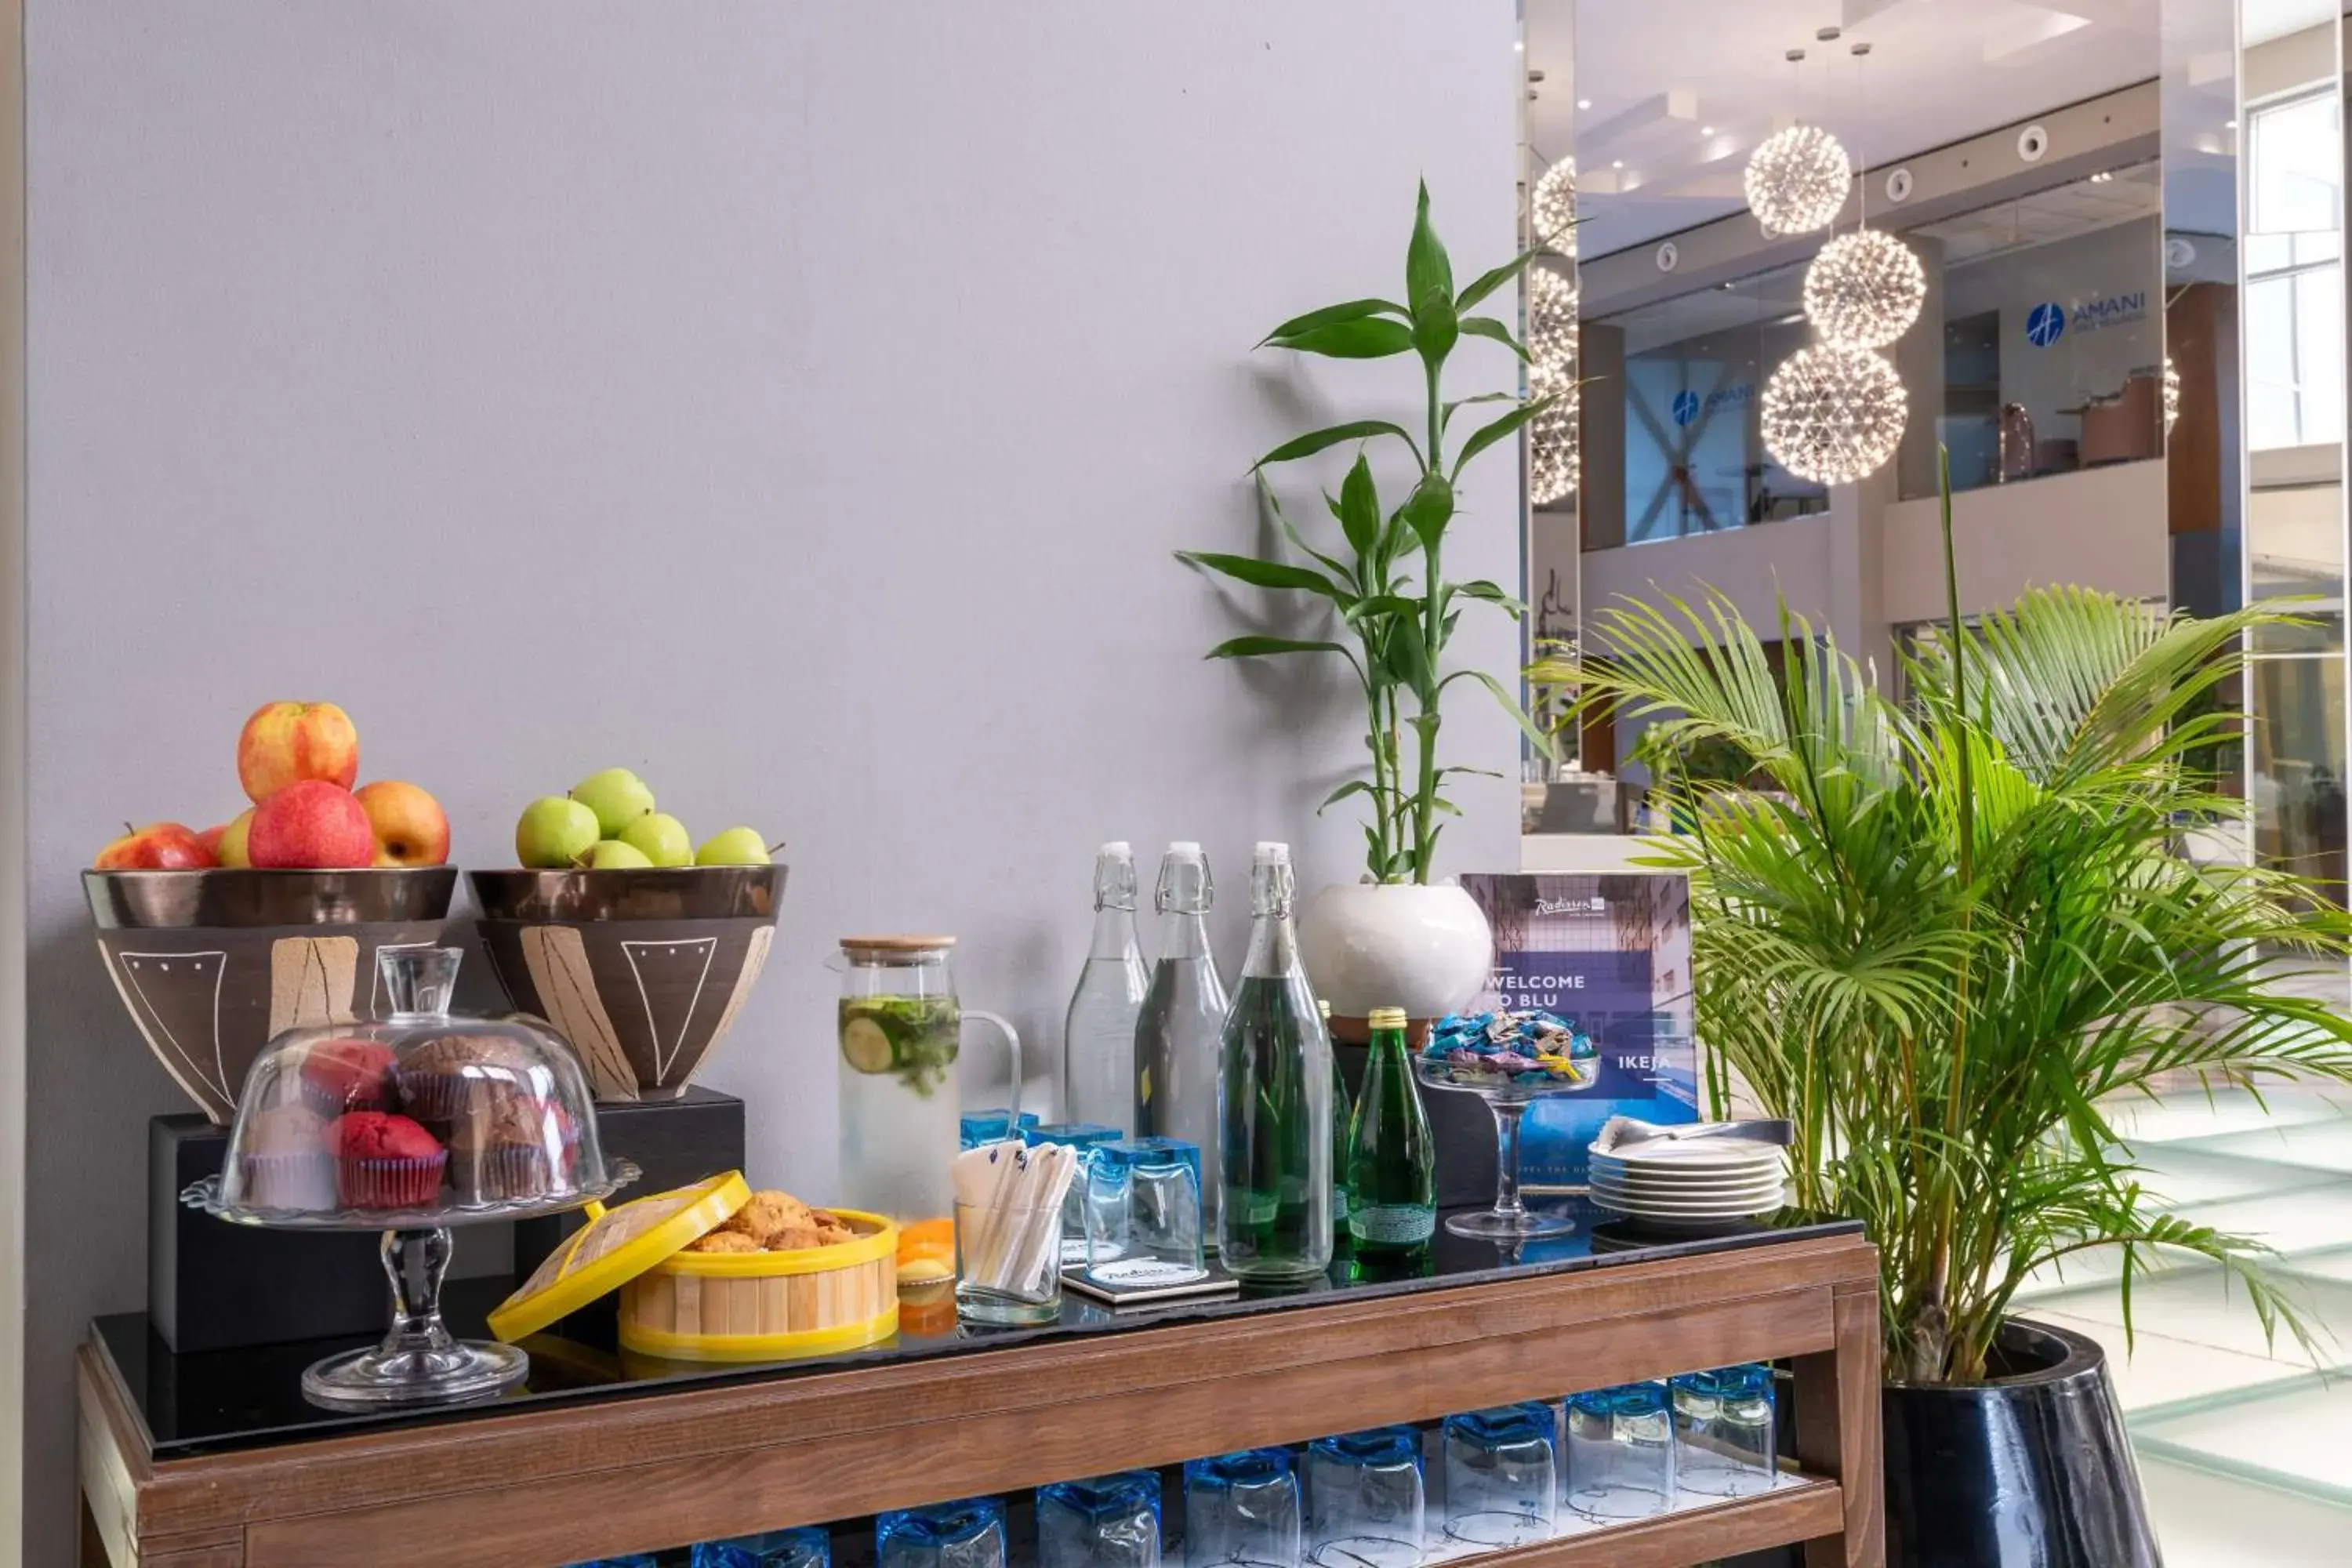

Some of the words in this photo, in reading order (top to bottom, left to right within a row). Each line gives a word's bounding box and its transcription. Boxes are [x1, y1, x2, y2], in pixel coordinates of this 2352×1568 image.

[2072, 291, 2146, 325] AMANI
[1486, 975, 1584, 989] WELCOME
[1519, 993, 1557, 1007] BLU
[1618, 1056, 1671, 1072] IKEJA
